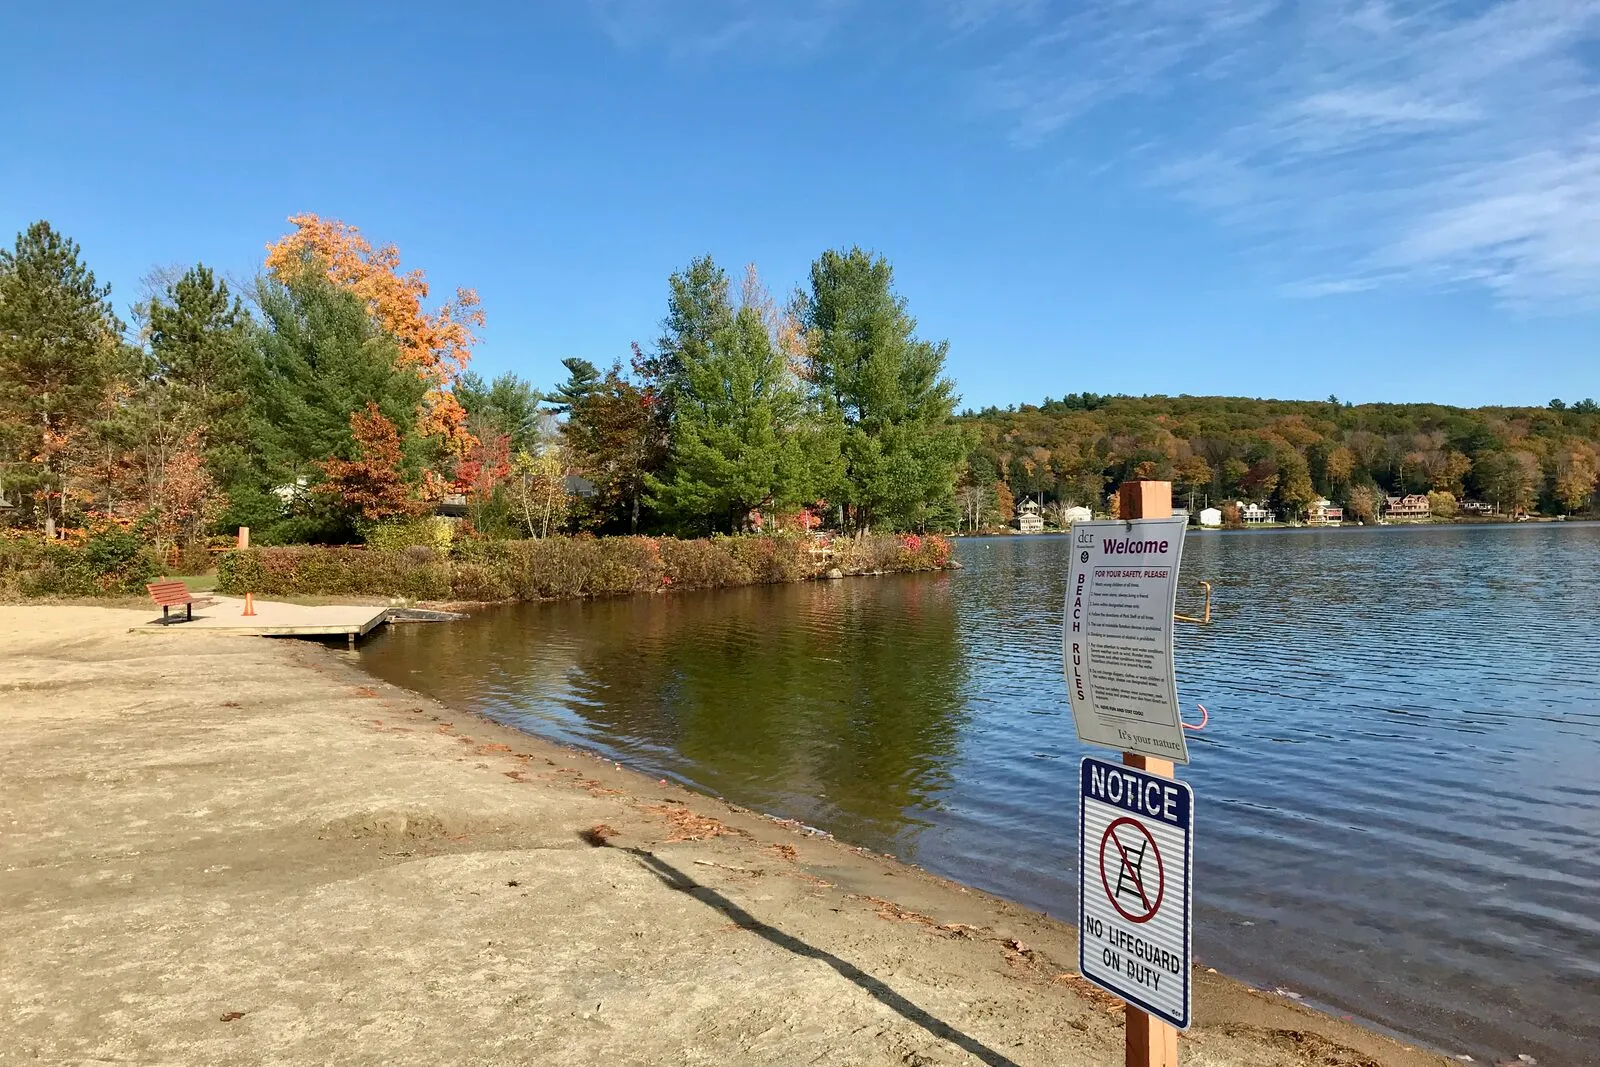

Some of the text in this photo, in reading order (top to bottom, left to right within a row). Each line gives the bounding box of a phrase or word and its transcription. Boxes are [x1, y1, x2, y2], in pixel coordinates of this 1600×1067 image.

[1078, 529, 1094, 543] dcr
[1103, 538, 1168, 554] Welcome
[1094, 570, 1168, 579] FOR YOUR SAFETY, PLEASE!
[1072, 573, 1085, 701] BEACH RULES
[1133, 734, 1151, 744] your
[1153, 738, 1181, 751] nature
[1091, 764, 1178, 822] NOTICE
[1086, 915, 1180, 975] NO LIFEGUARD
[1103, 947, 1161, 991] ON DUTY
